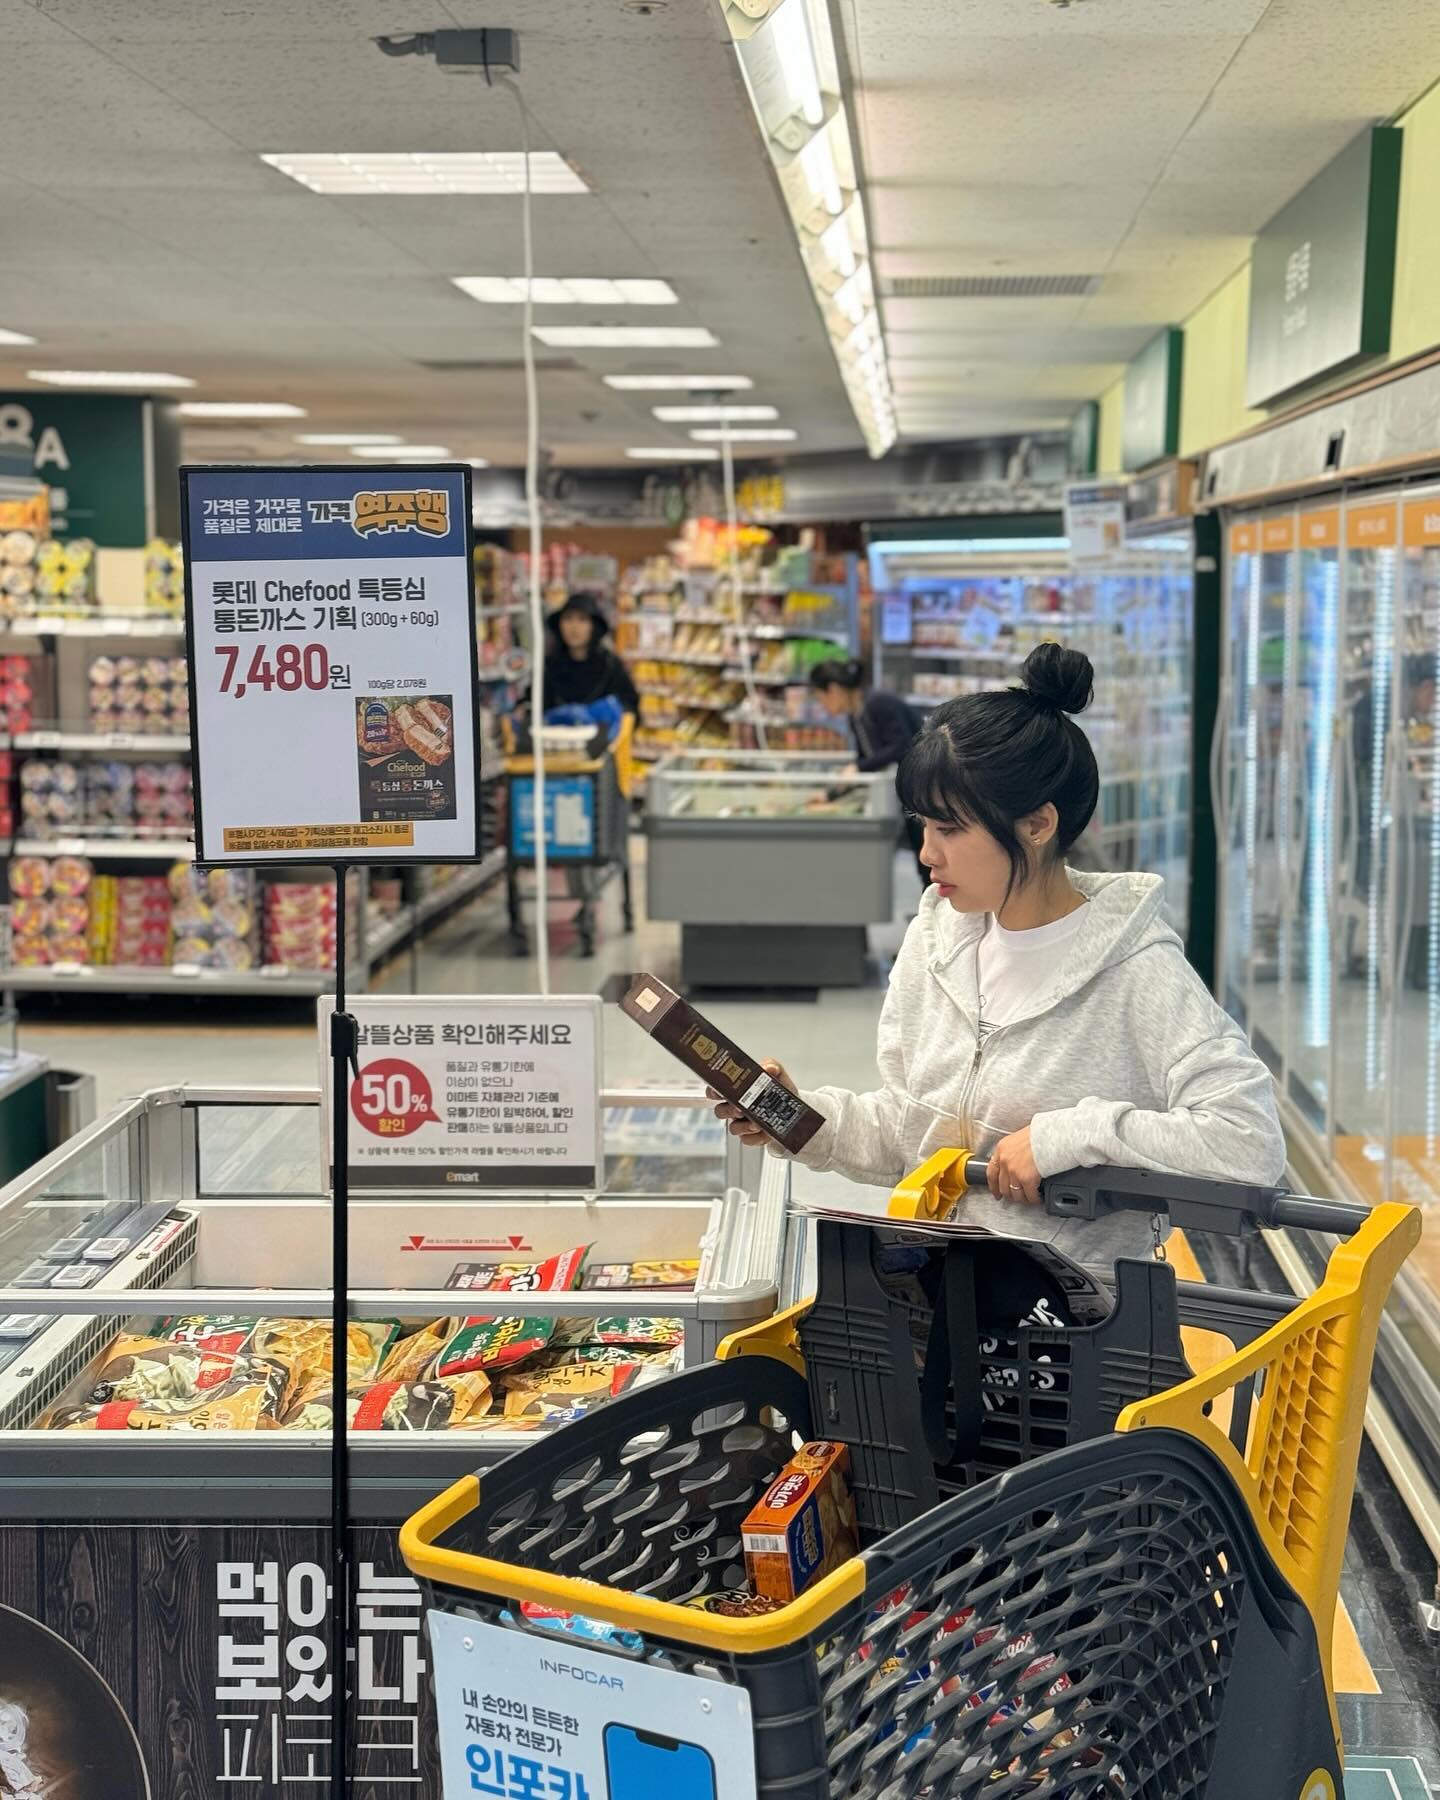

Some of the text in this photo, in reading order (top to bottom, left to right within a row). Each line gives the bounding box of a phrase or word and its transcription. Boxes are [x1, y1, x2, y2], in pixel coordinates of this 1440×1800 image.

[203, 499, 302, 515] 가격은 거꾸로
[309, 490, 449, 537] 가격 역주행
[203, 517, 303, 534] 품질은 제대로
[212, 577, 426, 605] 롯데 Chefood 특등심
[213, 607, 306, 633] 통돈까스
[313, 606, 357, 630] 기획
[368, 679, 395, 690] 100g당
[441, 1024, 572, 1047] 확인해주세요
[446, 1061, 535, 1073] 품질과 유통기한에
[446, 1076, 513, 1088] 이상이 없으나
[361, 1074, 428, 1116] 50%
[446, 1091, 560, 1103] 이마트 자체관리 기준에
[447, 1106, 574, 1119] 유통기한이 임박하여, 할인
[378, 1118, 406, 1133] 할인
[447, 1122, 568, 1134] 판매하는 알뜰상품입니다
[446, 1171, 480, 1183] emart
[539, 1658, 625, 1691] INFOCAR
[462, 1688, 580, 1736] 내 손안의 든든한
[465, 1714, 562, 1757] 자동차 전문가
[216, 1713, 424, 1785] 피코크
